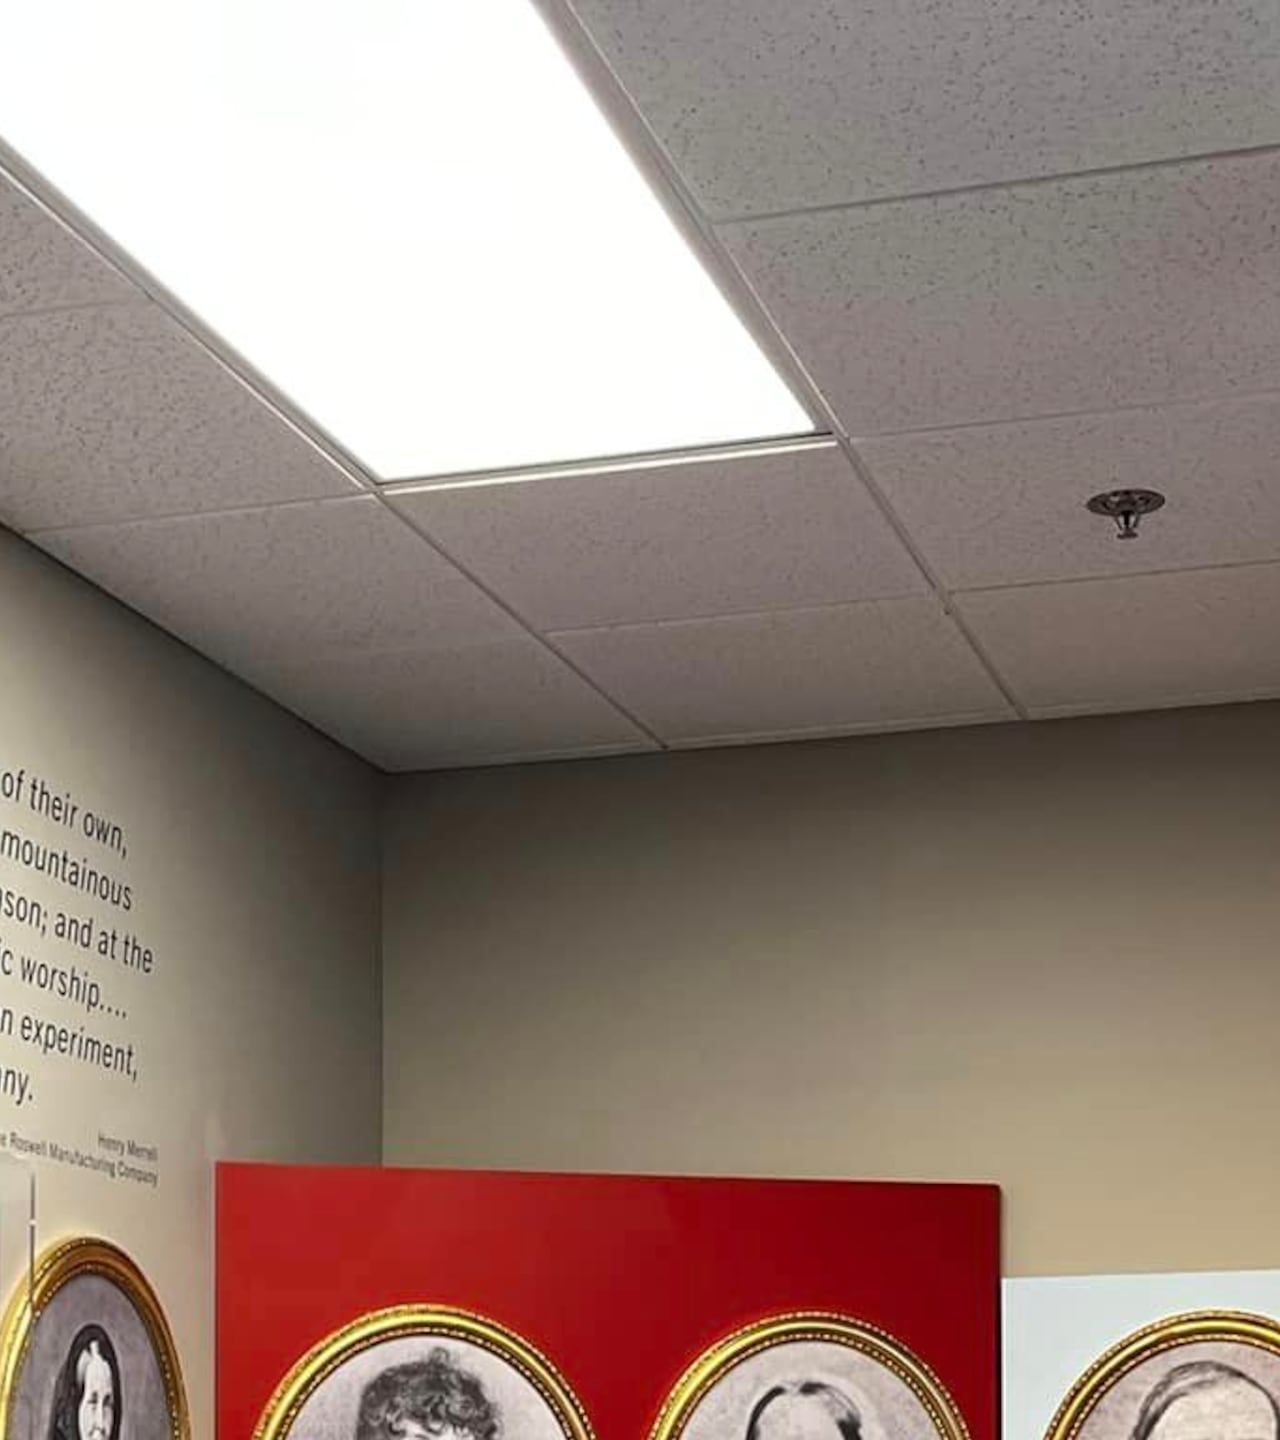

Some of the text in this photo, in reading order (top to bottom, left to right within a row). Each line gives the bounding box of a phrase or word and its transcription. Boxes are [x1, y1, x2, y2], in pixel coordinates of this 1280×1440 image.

[0, 768, 26, 804] of
[29, 777, 79, 829] their
[82, 811, 127, 860] own,
[0, 829, 132, 912] mountainous
[54, 912, 94, 950] and
[97, 928, 119, 961] at
[122, 933, 153, 974] the
[19, 1014, 138, 1083] experiment,
